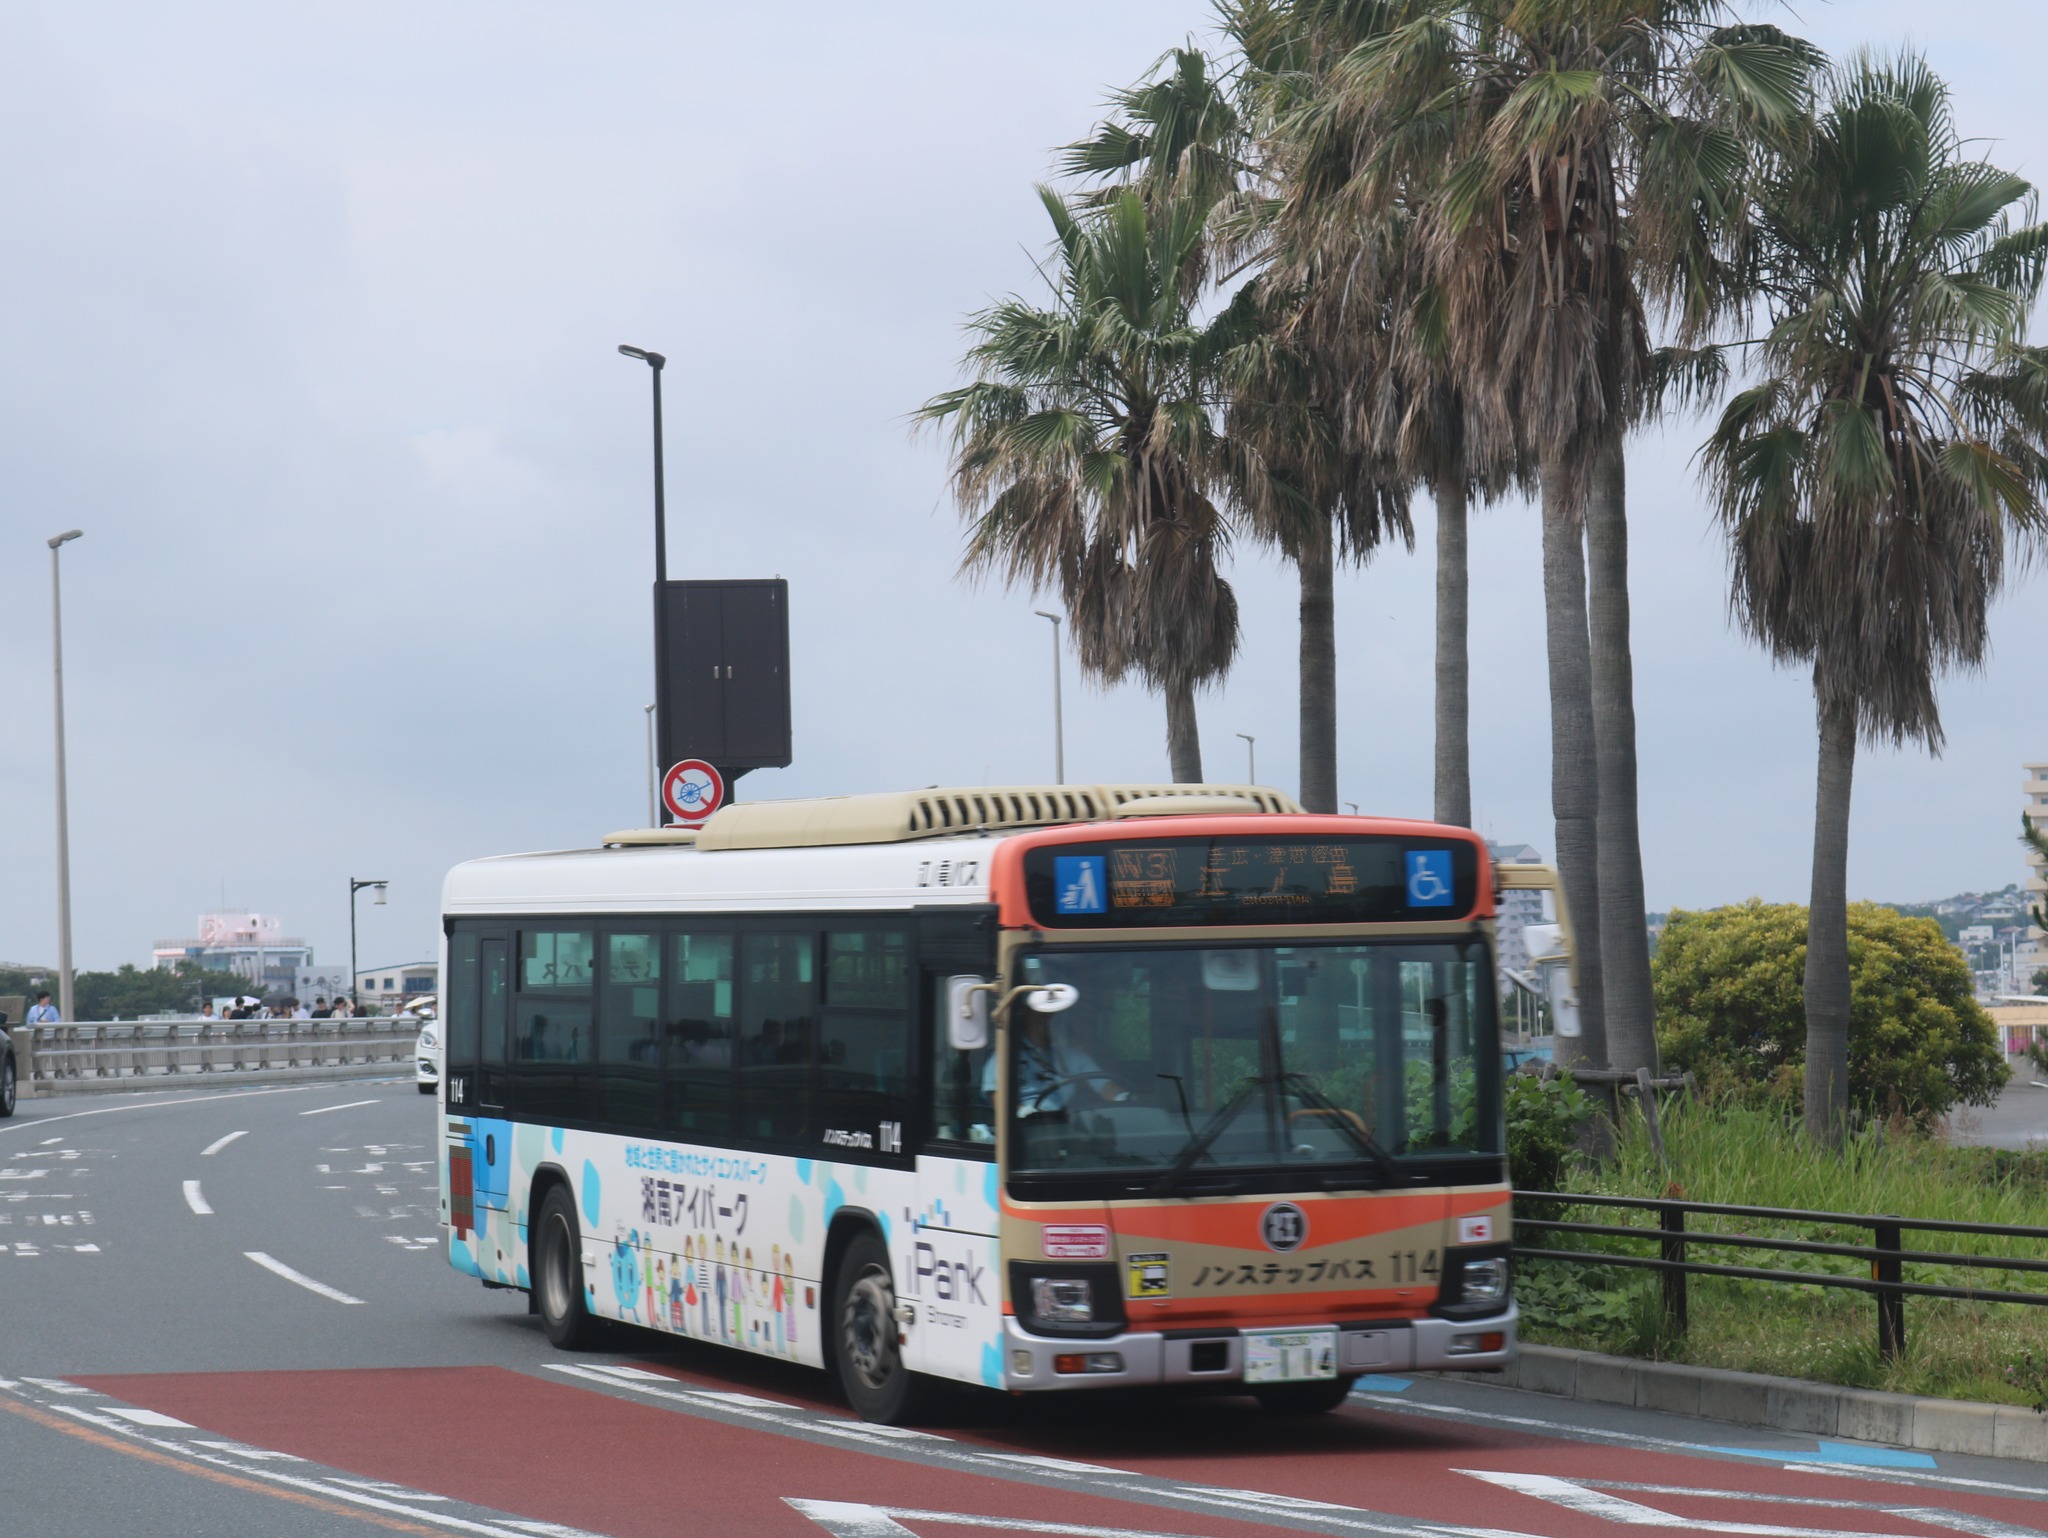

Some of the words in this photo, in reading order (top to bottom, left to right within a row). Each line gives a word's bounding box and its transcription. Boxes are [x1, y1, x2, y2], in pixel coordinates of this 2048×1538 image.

[450, 1078, 463, 1103] 114
[879, 1120, 902, 1153] 114
[641, 1175, 748, 1236] 湘南アイパーク
[905, 1241, 988, 1306] iPark
[1192, 1259, 1376, 1287] ノンステップバス
[1388, 1249, 1440, 1283] 114
